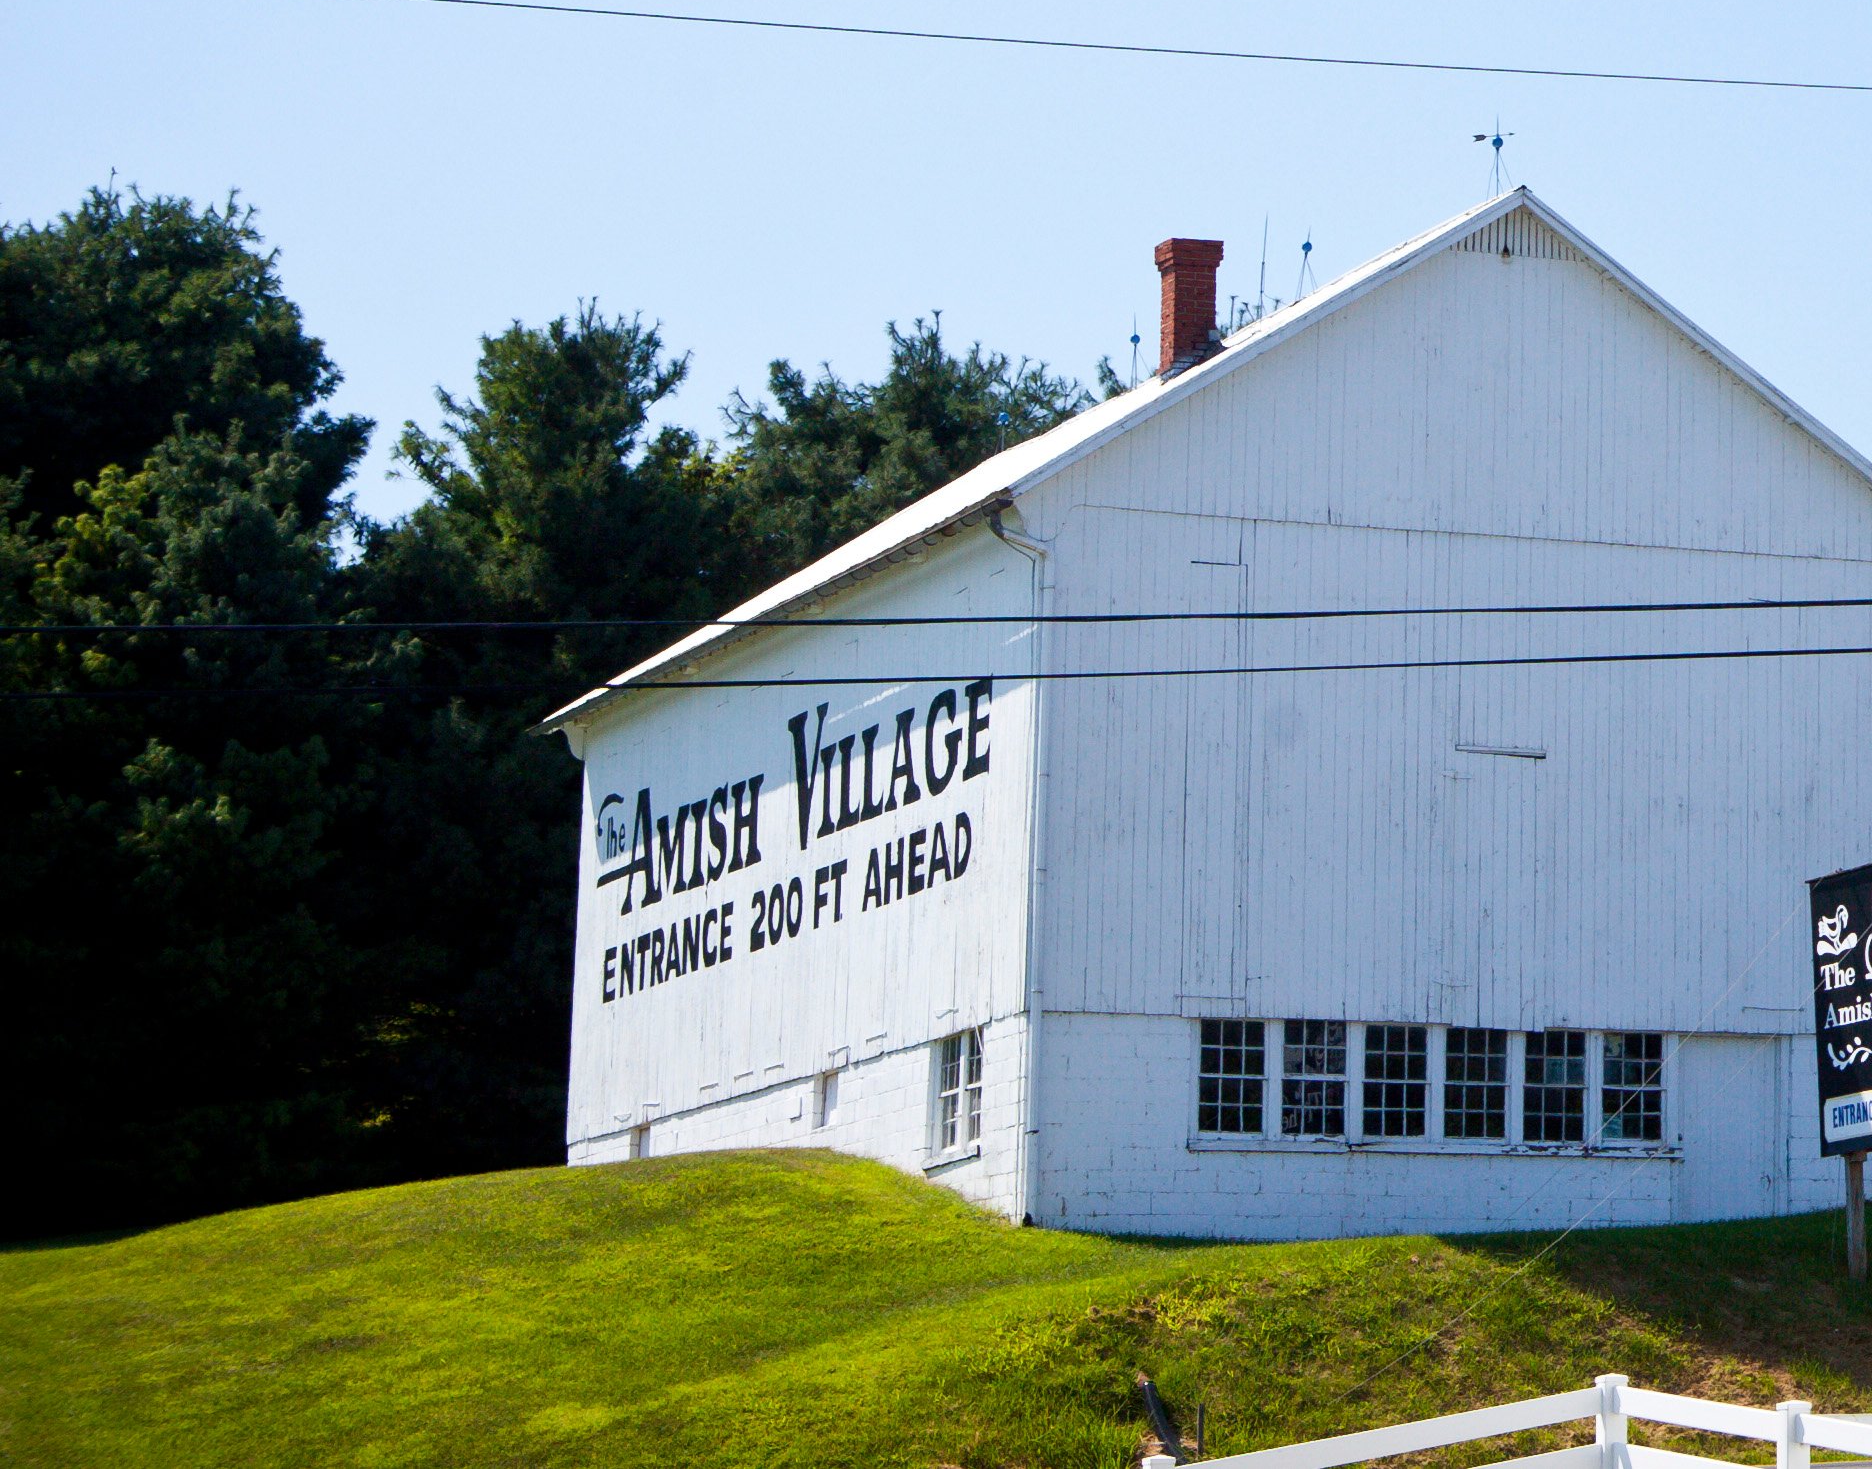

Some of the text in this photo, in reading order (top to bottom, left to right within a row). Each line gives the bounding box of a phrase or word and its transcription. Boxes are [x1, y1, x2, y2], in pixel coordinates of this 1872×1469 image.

[597, 793, 626, 859] The
[602, 812, 972, 1004] ENTRANCE 200 FT AHEAD
[1821, 962, 1856, 990] The
